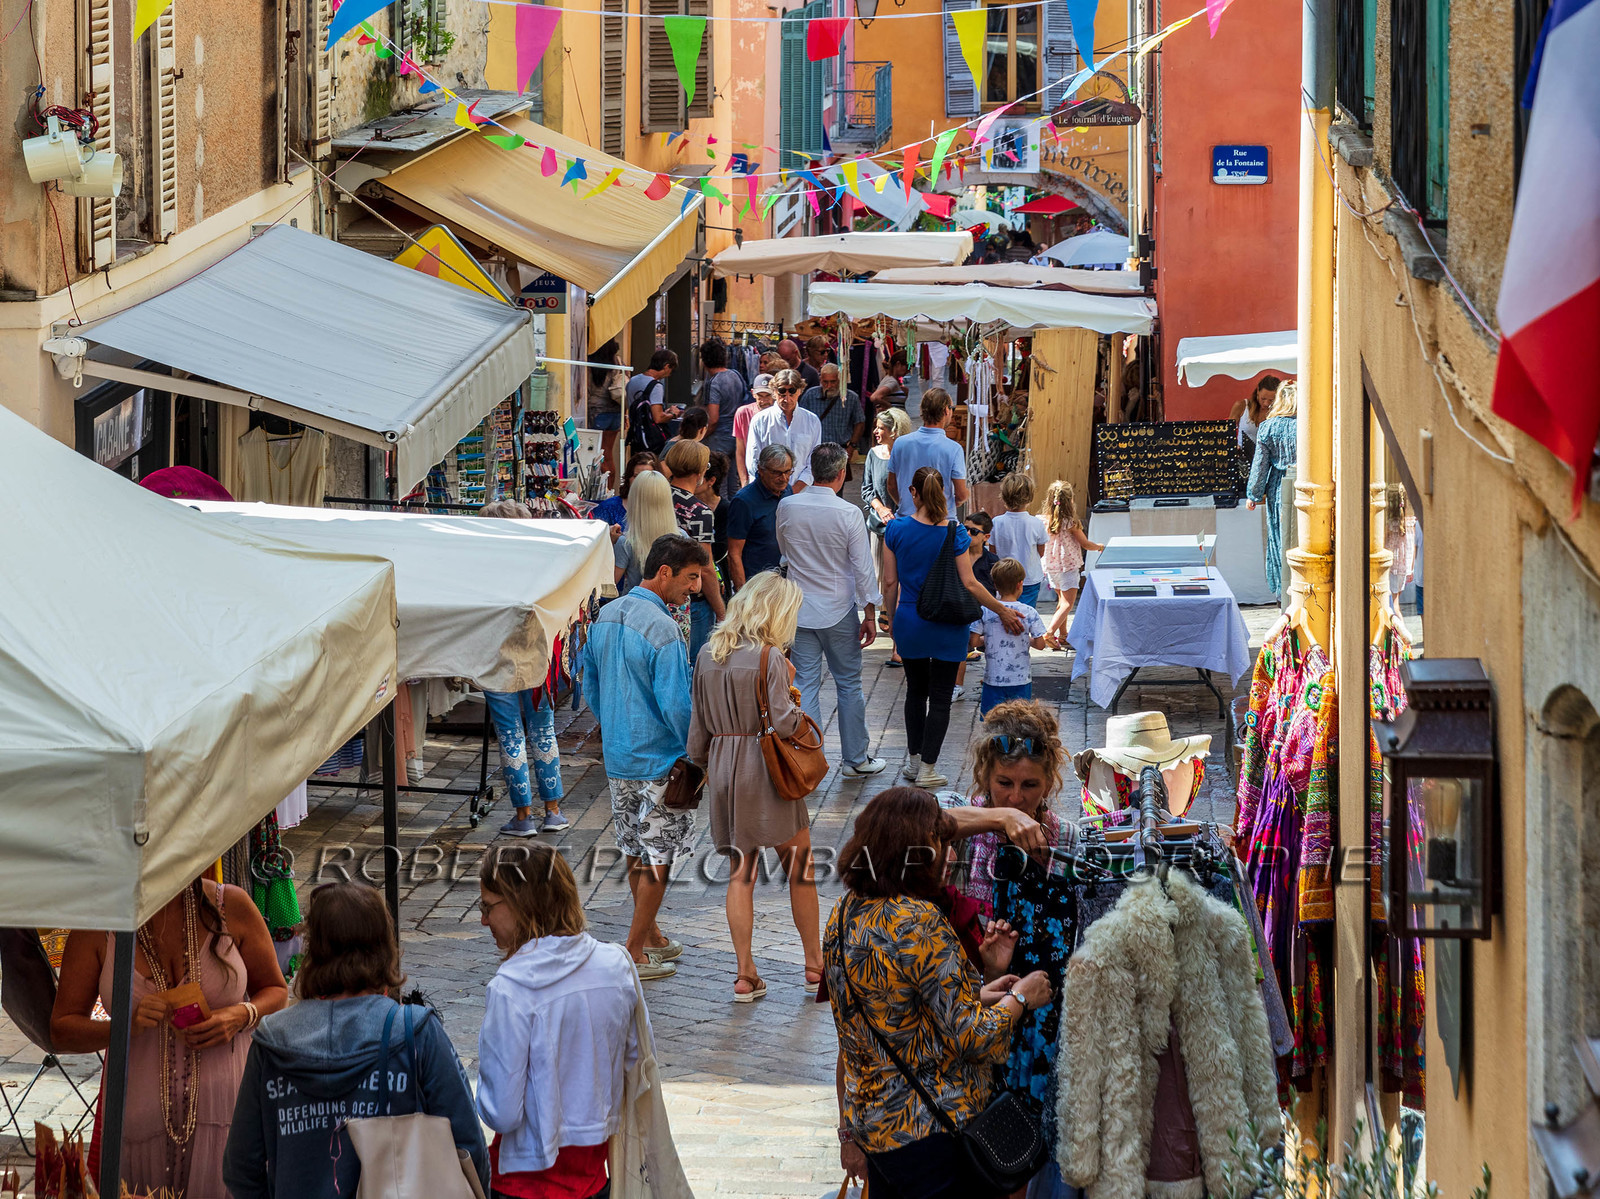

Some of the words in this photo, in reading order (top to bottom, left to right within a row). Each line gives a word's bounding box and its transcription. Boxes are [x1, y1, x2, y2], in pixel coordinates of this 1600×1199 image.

[1058, 116, 1068, 124] Le
[1072, 114, 1097, 124] fournil
[1100, 114, 1134, 125] d'Eugène
[534, 279, 556, 287] JEUX
[515, 296, 559, 310] LOTO
[96, 412, 130, 465] CABANE
[278, 1100, 346, 1122] DEFENDING
[279, 1116, 329, 1136] WILDLIFE
